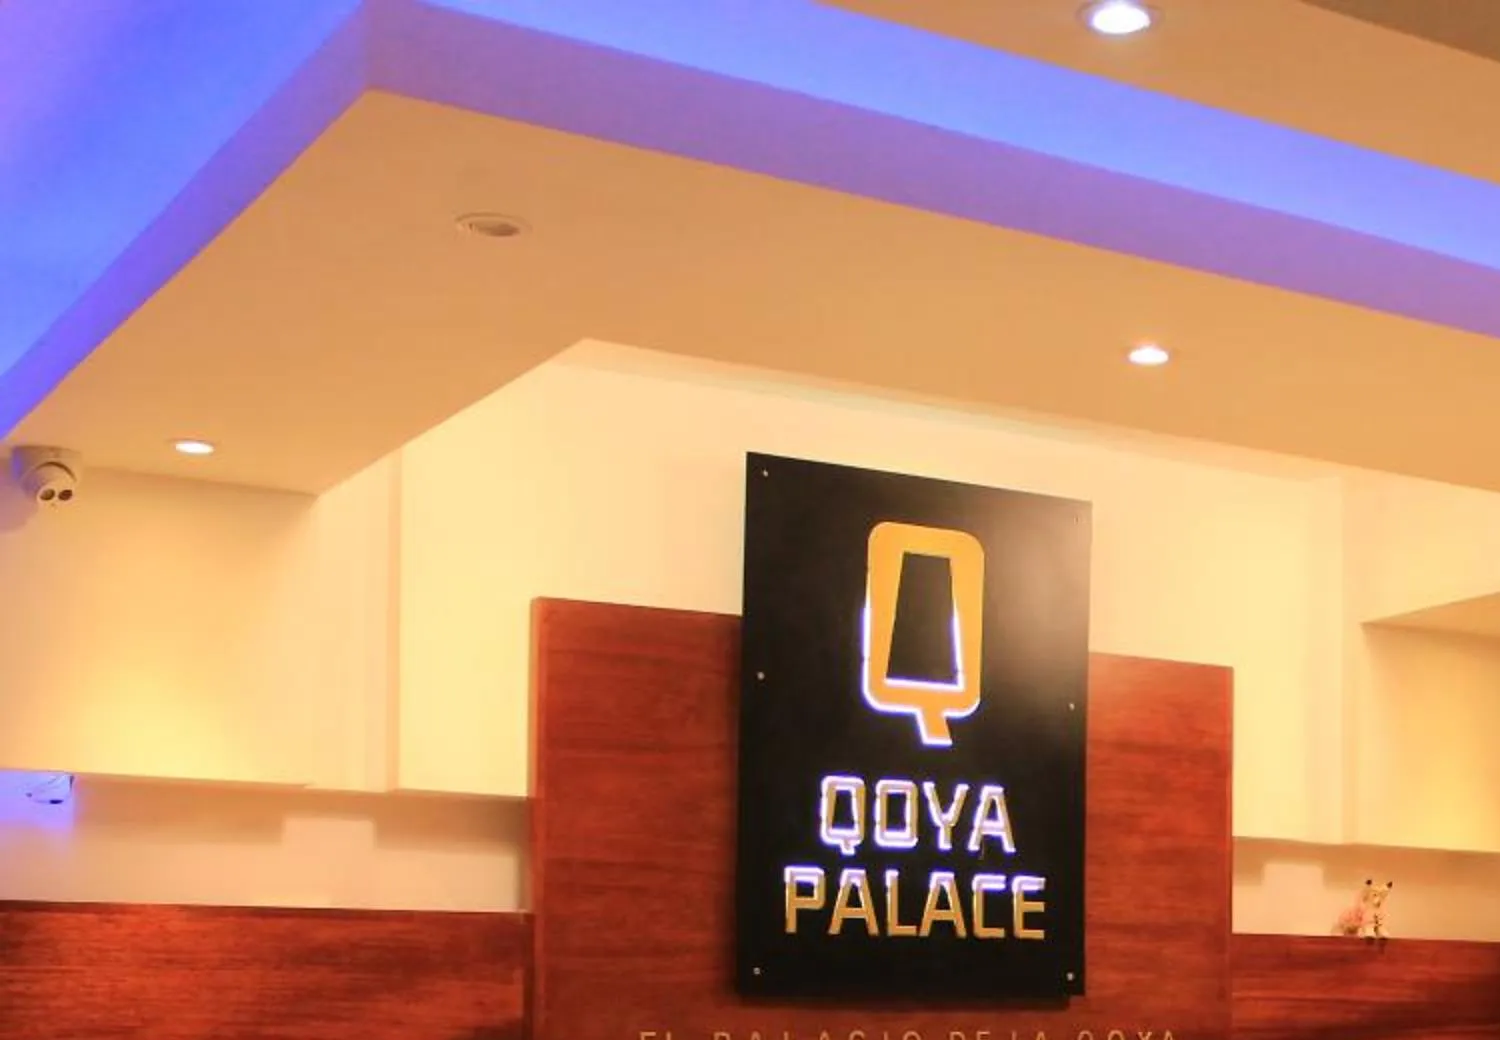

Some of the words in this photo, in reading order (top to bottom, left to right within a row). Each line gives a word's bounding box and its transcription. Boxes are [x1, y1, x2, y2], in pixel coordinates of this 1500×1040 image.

[863, 521, 985, 746] Q
[819, 775, 1016, 856] QOYA
[783, 866, 1046, 941] PALACE
